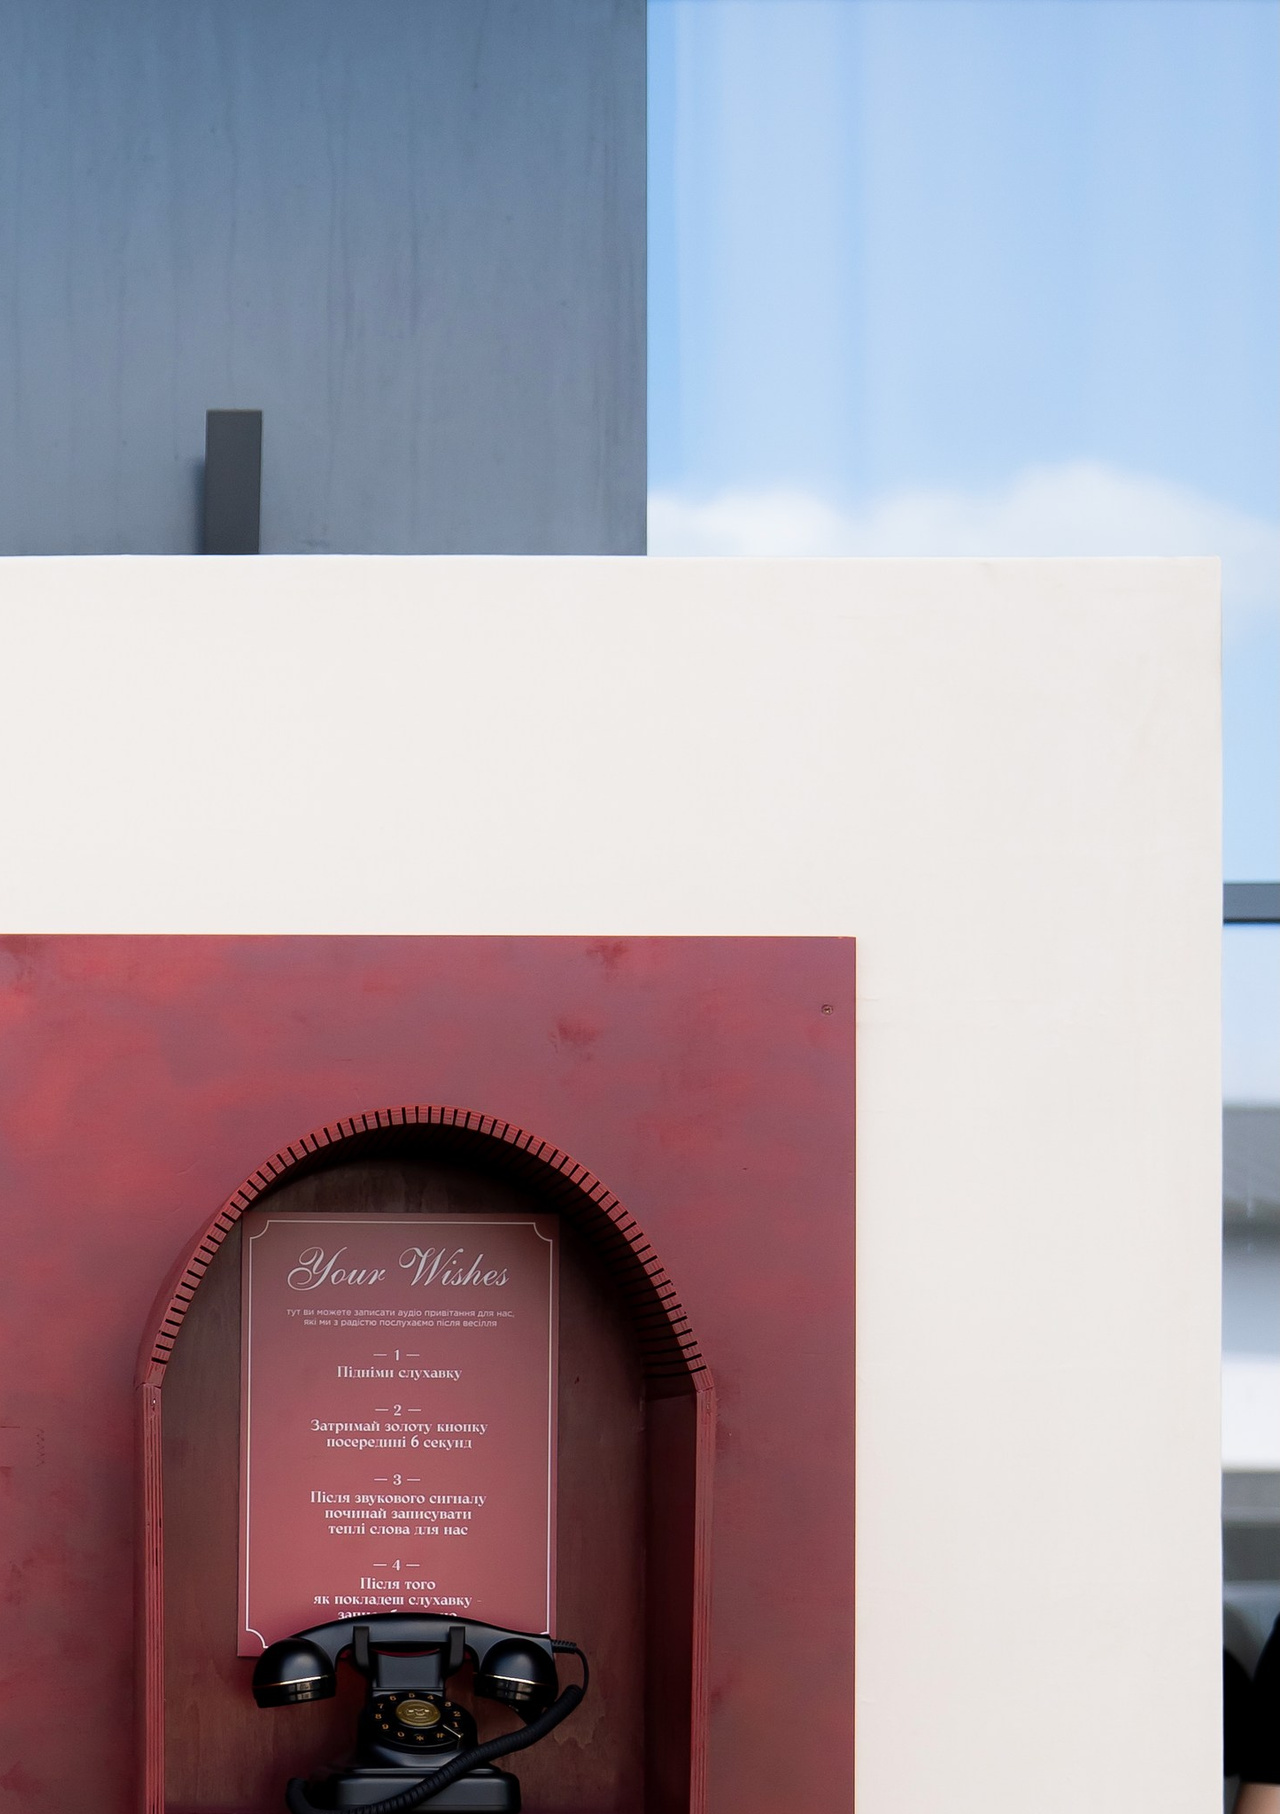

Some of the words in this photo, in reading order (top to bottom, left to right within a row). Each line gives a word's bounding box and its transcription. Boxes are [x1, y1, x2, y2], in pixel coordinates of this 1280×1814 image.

[287, 1246, 385, 1291] Your
[398, 1247, 510, 1287] Wishes
[286, 1309, 301, 1317] тут
[354, 1309, 396, 1317] записати
[397, 1309, 422, 1318] аудіо
[424, 1309, 476, 1318] привітання
[477, 1310, 495, 1318] для
[303, 1318, 317, 1326] які
[340, 1318, 377, 1327] радістю
[379, 1319, 434, 1328] послухаємо
[436, 1319, 461, 1327] після
[462, 1319, 498, 1327] весілля
[337, 1365, 394, 1379] Підніми
[398, 1369, 463, 1382] слухавку
[310, 1418, 380, 1434] Затримай
[384, 1422, 433, 1434] золоту
[436, 1423, 489, 1435] кнопку
[326, 1436, 406, 1450] посередині
[410, 1435, 419, 1448] 6
[423, 1438, 473, 1451] секунд
[310, 1490, 351, 1504] Після
[354, 1494, 425, 1507] звукового
[429, 1494, 487, 1507] сигналу
[324, 1507, 387, 1520] починай
[391, 1509, 472, 1521] записувати
[328, 1523, 366, 1535] теплі
[369, 1525, 410, 1535] слова
[413, 1526, 439, 1536] для
[443, 1526, 468, 1536] нас
[360, 1577, 400, 1590] Після
[404, 1580, 436, 1591] того
[313, 1595, 330, 1605] як
[334, 1595, 404, 1606] покладеш
[408, 1596, 472, 1609] слухавку
